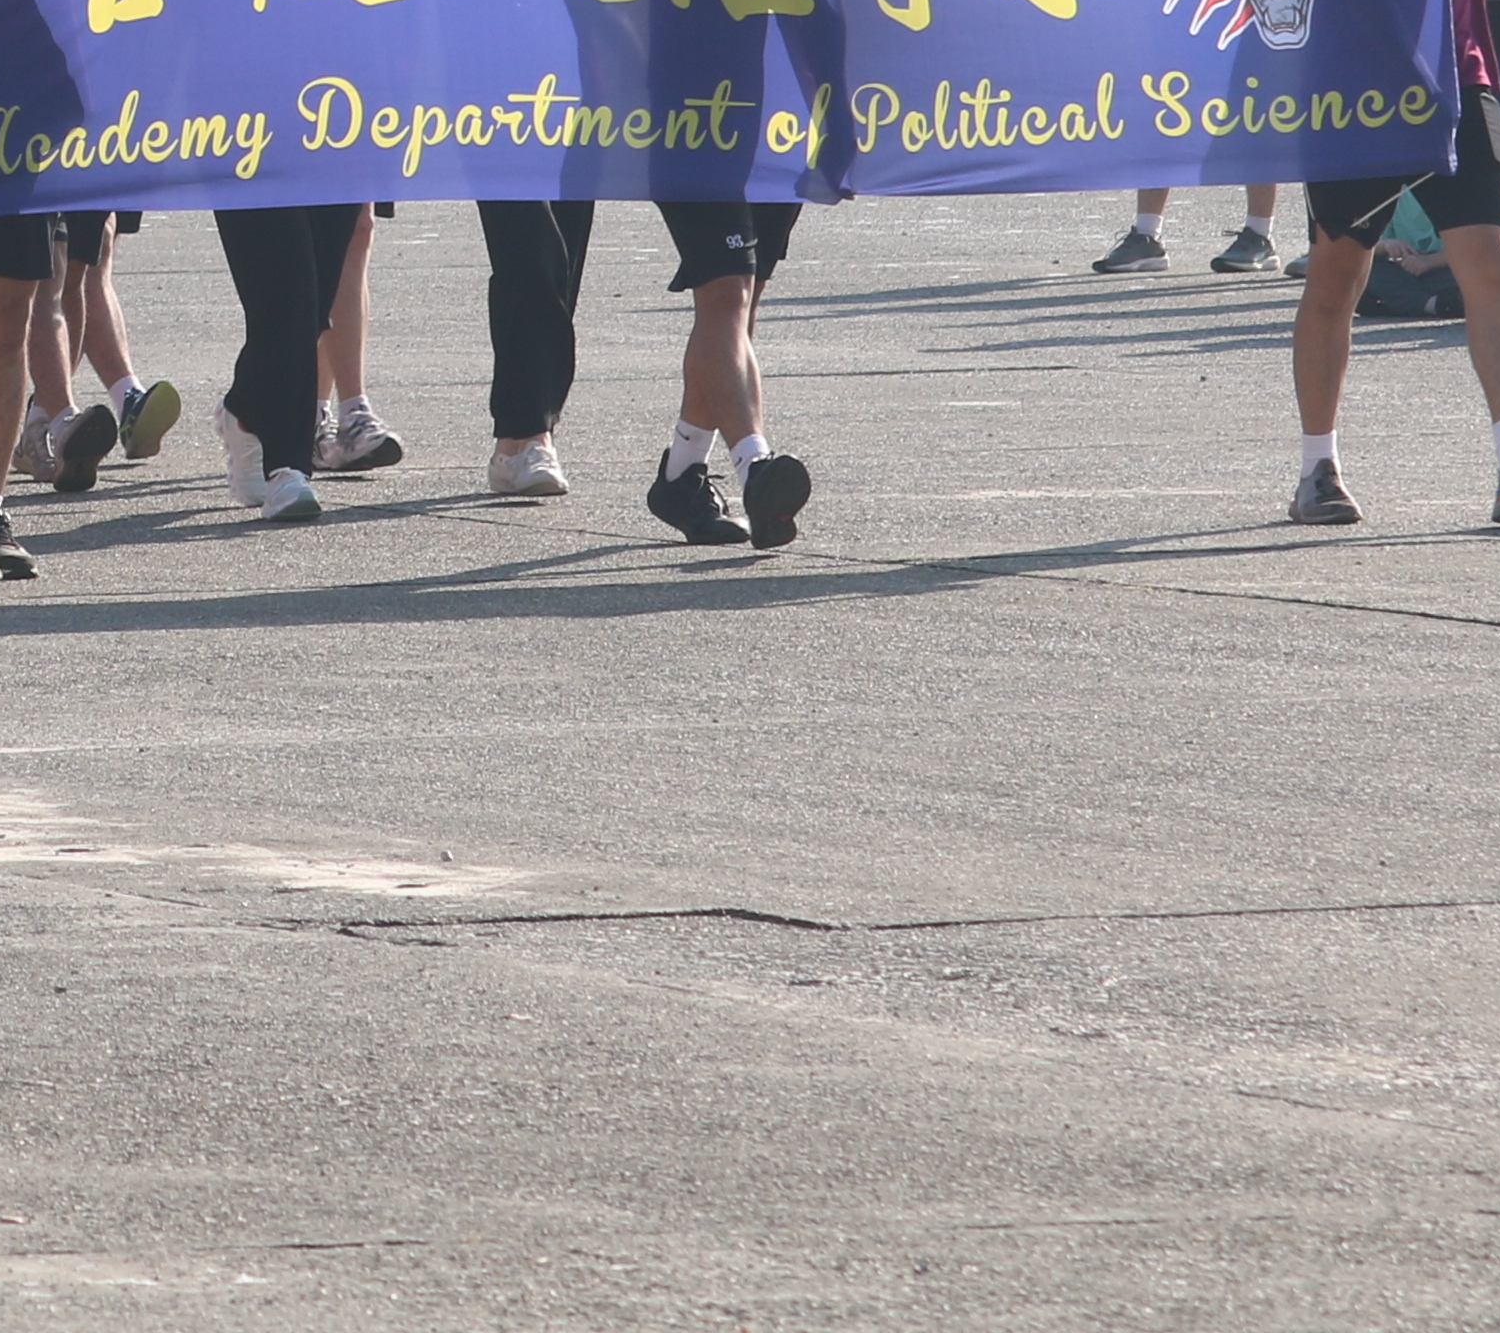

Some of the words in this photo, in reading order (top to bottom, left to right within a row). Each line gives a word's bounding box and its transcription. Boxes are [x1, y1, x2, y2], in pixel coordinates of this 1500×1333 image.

[297, 73, 755, 178] Department
[766, 82, 831, 170] of
[851, 72, 1123, 153] Political
[1141, 71, 1437, 136] Science
[726, 234, 744, 249] 93
